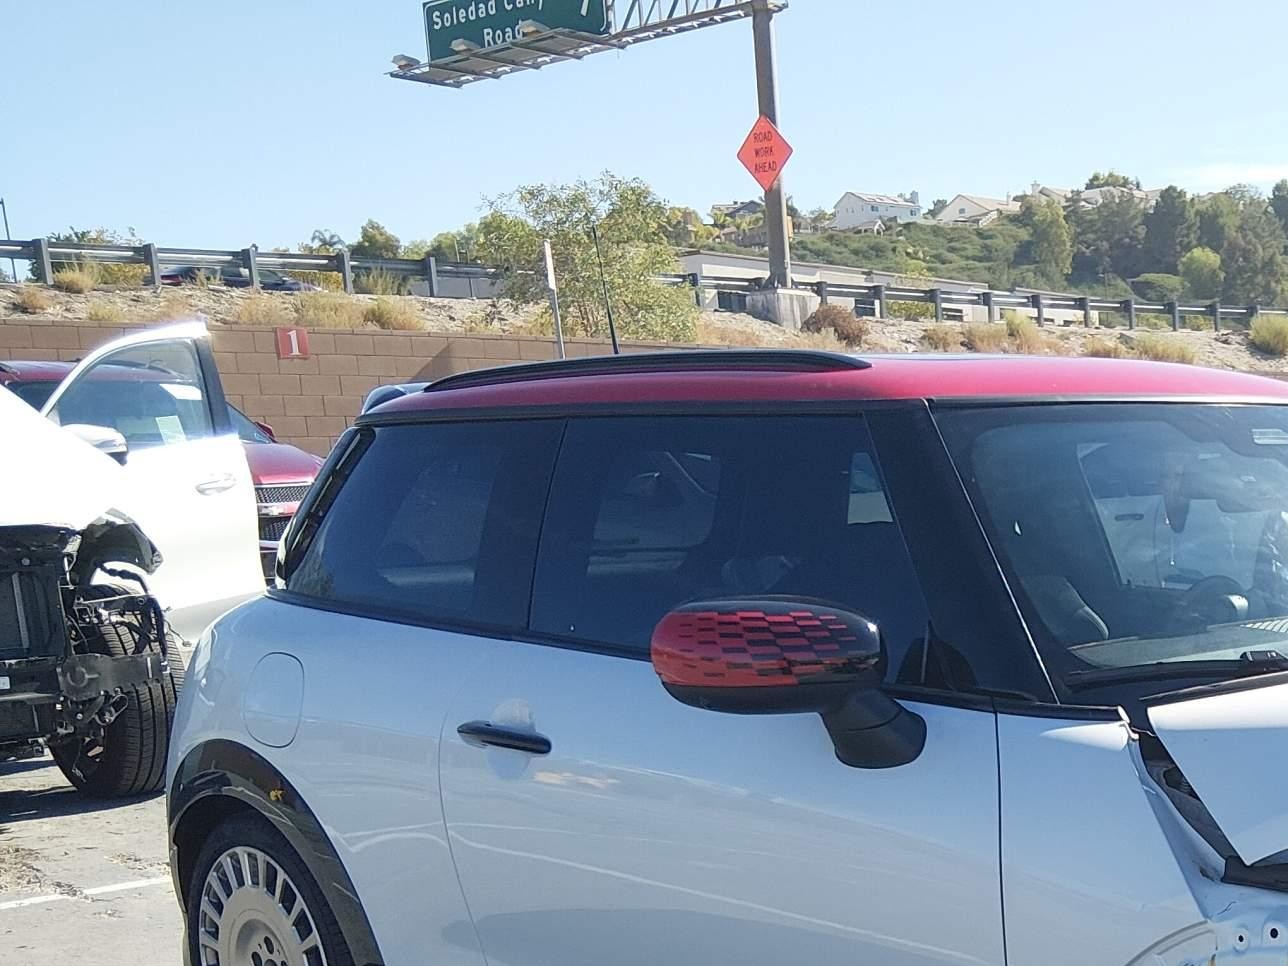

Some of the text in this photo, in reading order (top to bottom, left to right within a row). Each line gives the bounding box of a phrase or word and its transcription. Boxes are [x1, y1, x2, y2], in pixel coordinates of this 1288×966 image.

[432, 0, 496, 30] Soledad
[484, 20, 523, 48] Road
[753, 131, 773, 143] ROAD
[754, 146, 774, 158] WORK
[755, 161, 777, 174] AHEAD
[287, 330, 301, 356] 1
